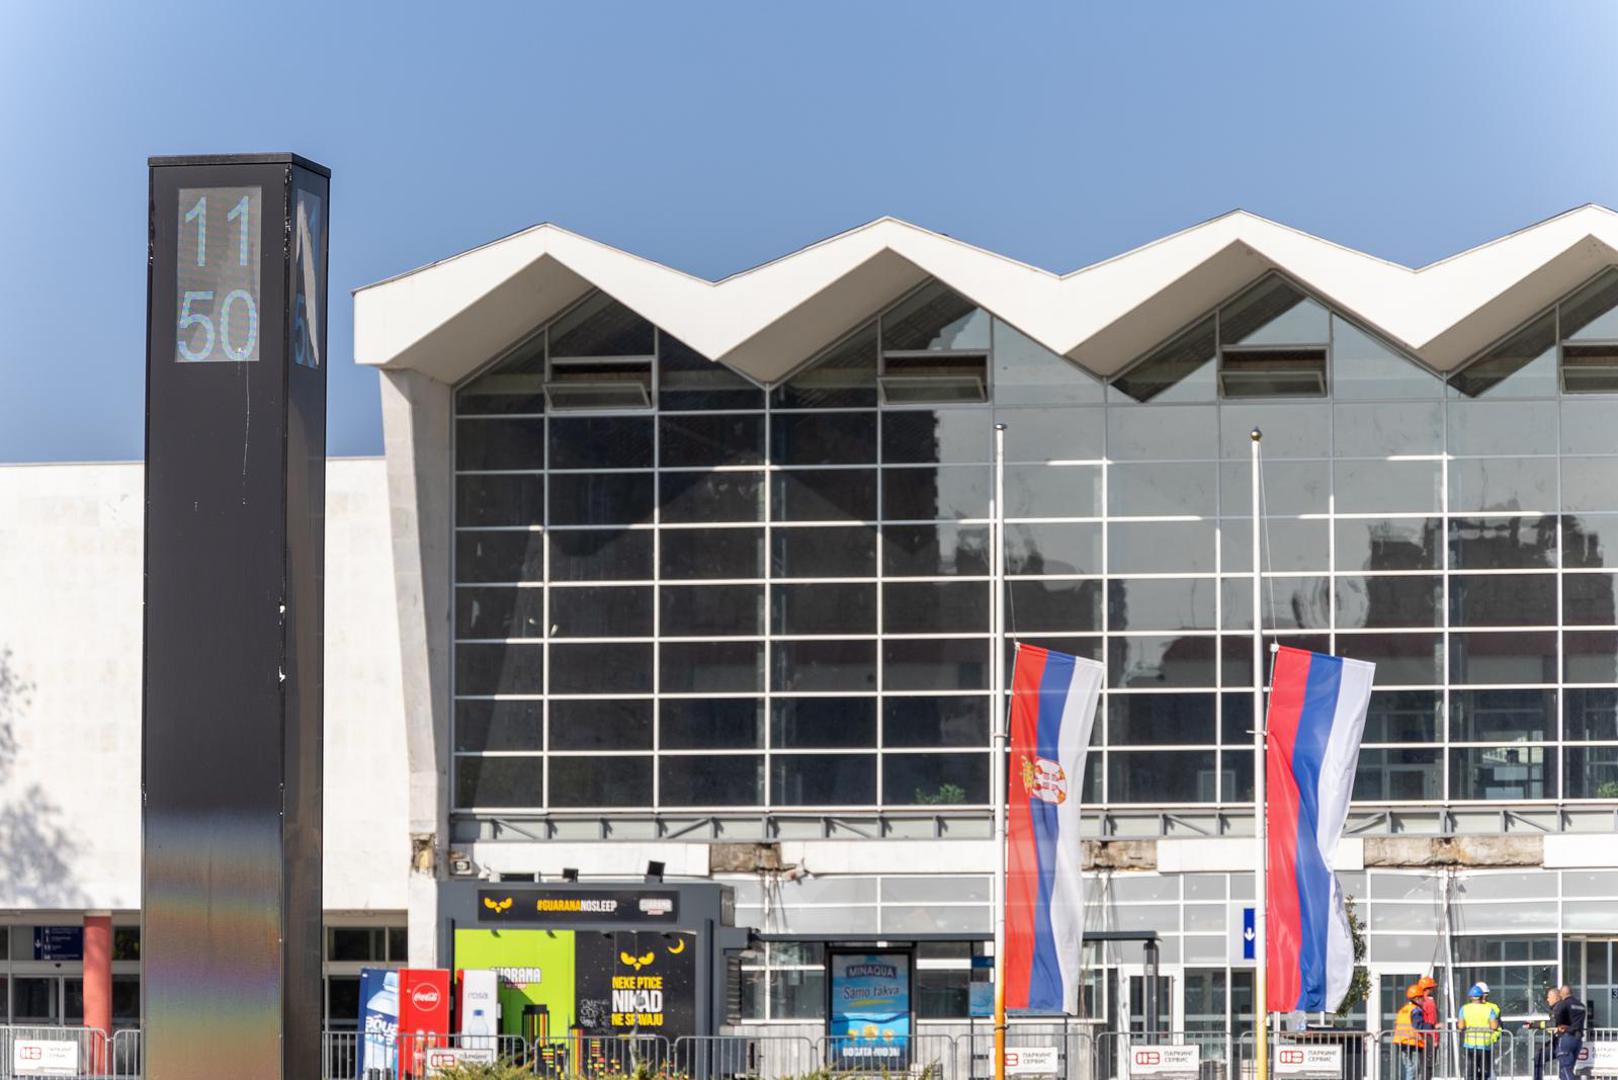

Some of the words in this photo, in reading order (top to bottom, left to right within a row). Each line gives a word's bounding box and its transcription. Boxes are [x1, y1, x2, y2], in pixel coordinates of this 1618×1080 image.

[185, 196, 248, 267] 11
[177, 289, 257, 361] 50
[849, 967, 894, 977] MINAQUA
[612, 976, 636, 989] NEKE
[637, 976, 663, 989] PTICE
[612, 990, 663, 1013] NIKAD
[612, 1013, 625, 1026] NE
